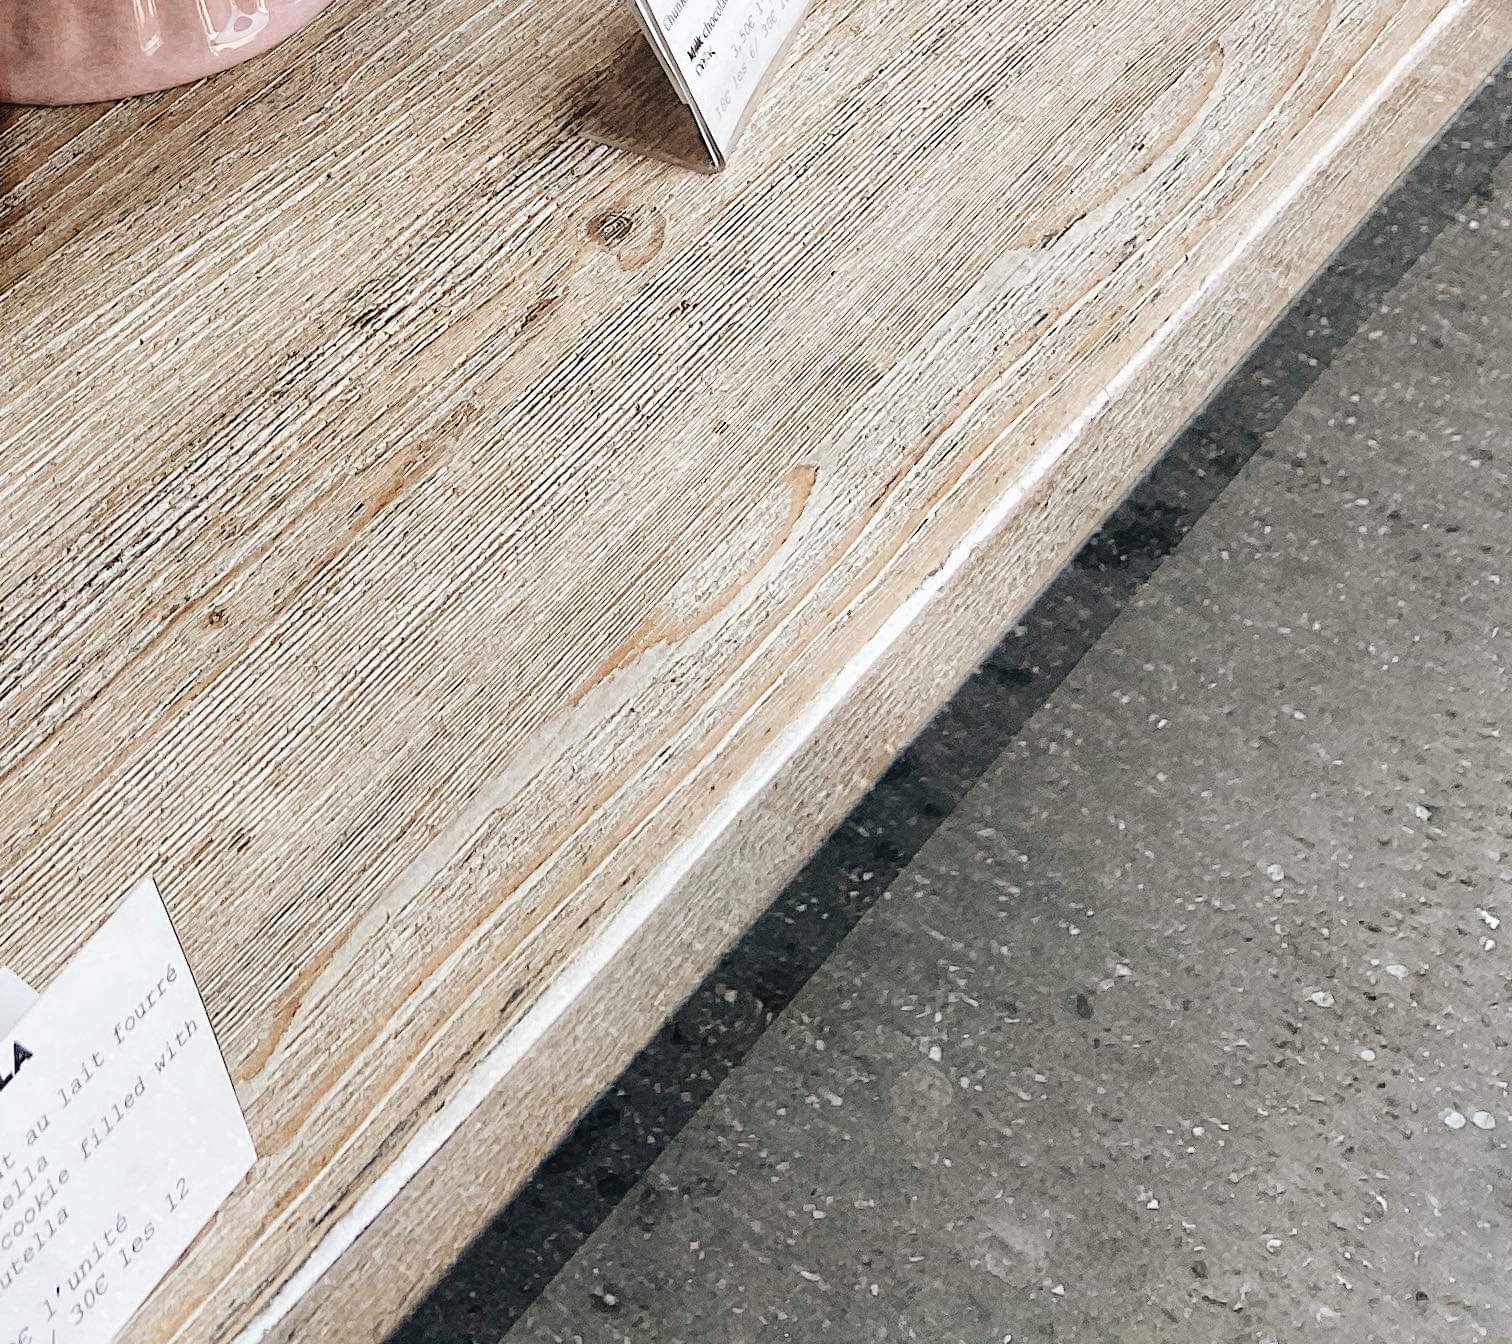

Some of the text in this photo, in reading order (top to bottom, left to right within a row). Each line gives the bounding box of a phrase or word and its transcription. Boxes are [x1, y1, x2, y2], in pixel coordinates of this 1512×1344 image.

[0, 1168, 70, 1251] cookie
[80, 1075, 147, 1161] filled
[154, 1016, 200, 1074] with
[26, 1113, 51, 1146] au
[58, 1051, 105, 1109] lait
[114, 962, 178, 1045] fourré
[71, 1273, 109, 1326] 30€
[118, 1221, 156, 1269] les
[165, 1177, 190, 1213] 12
